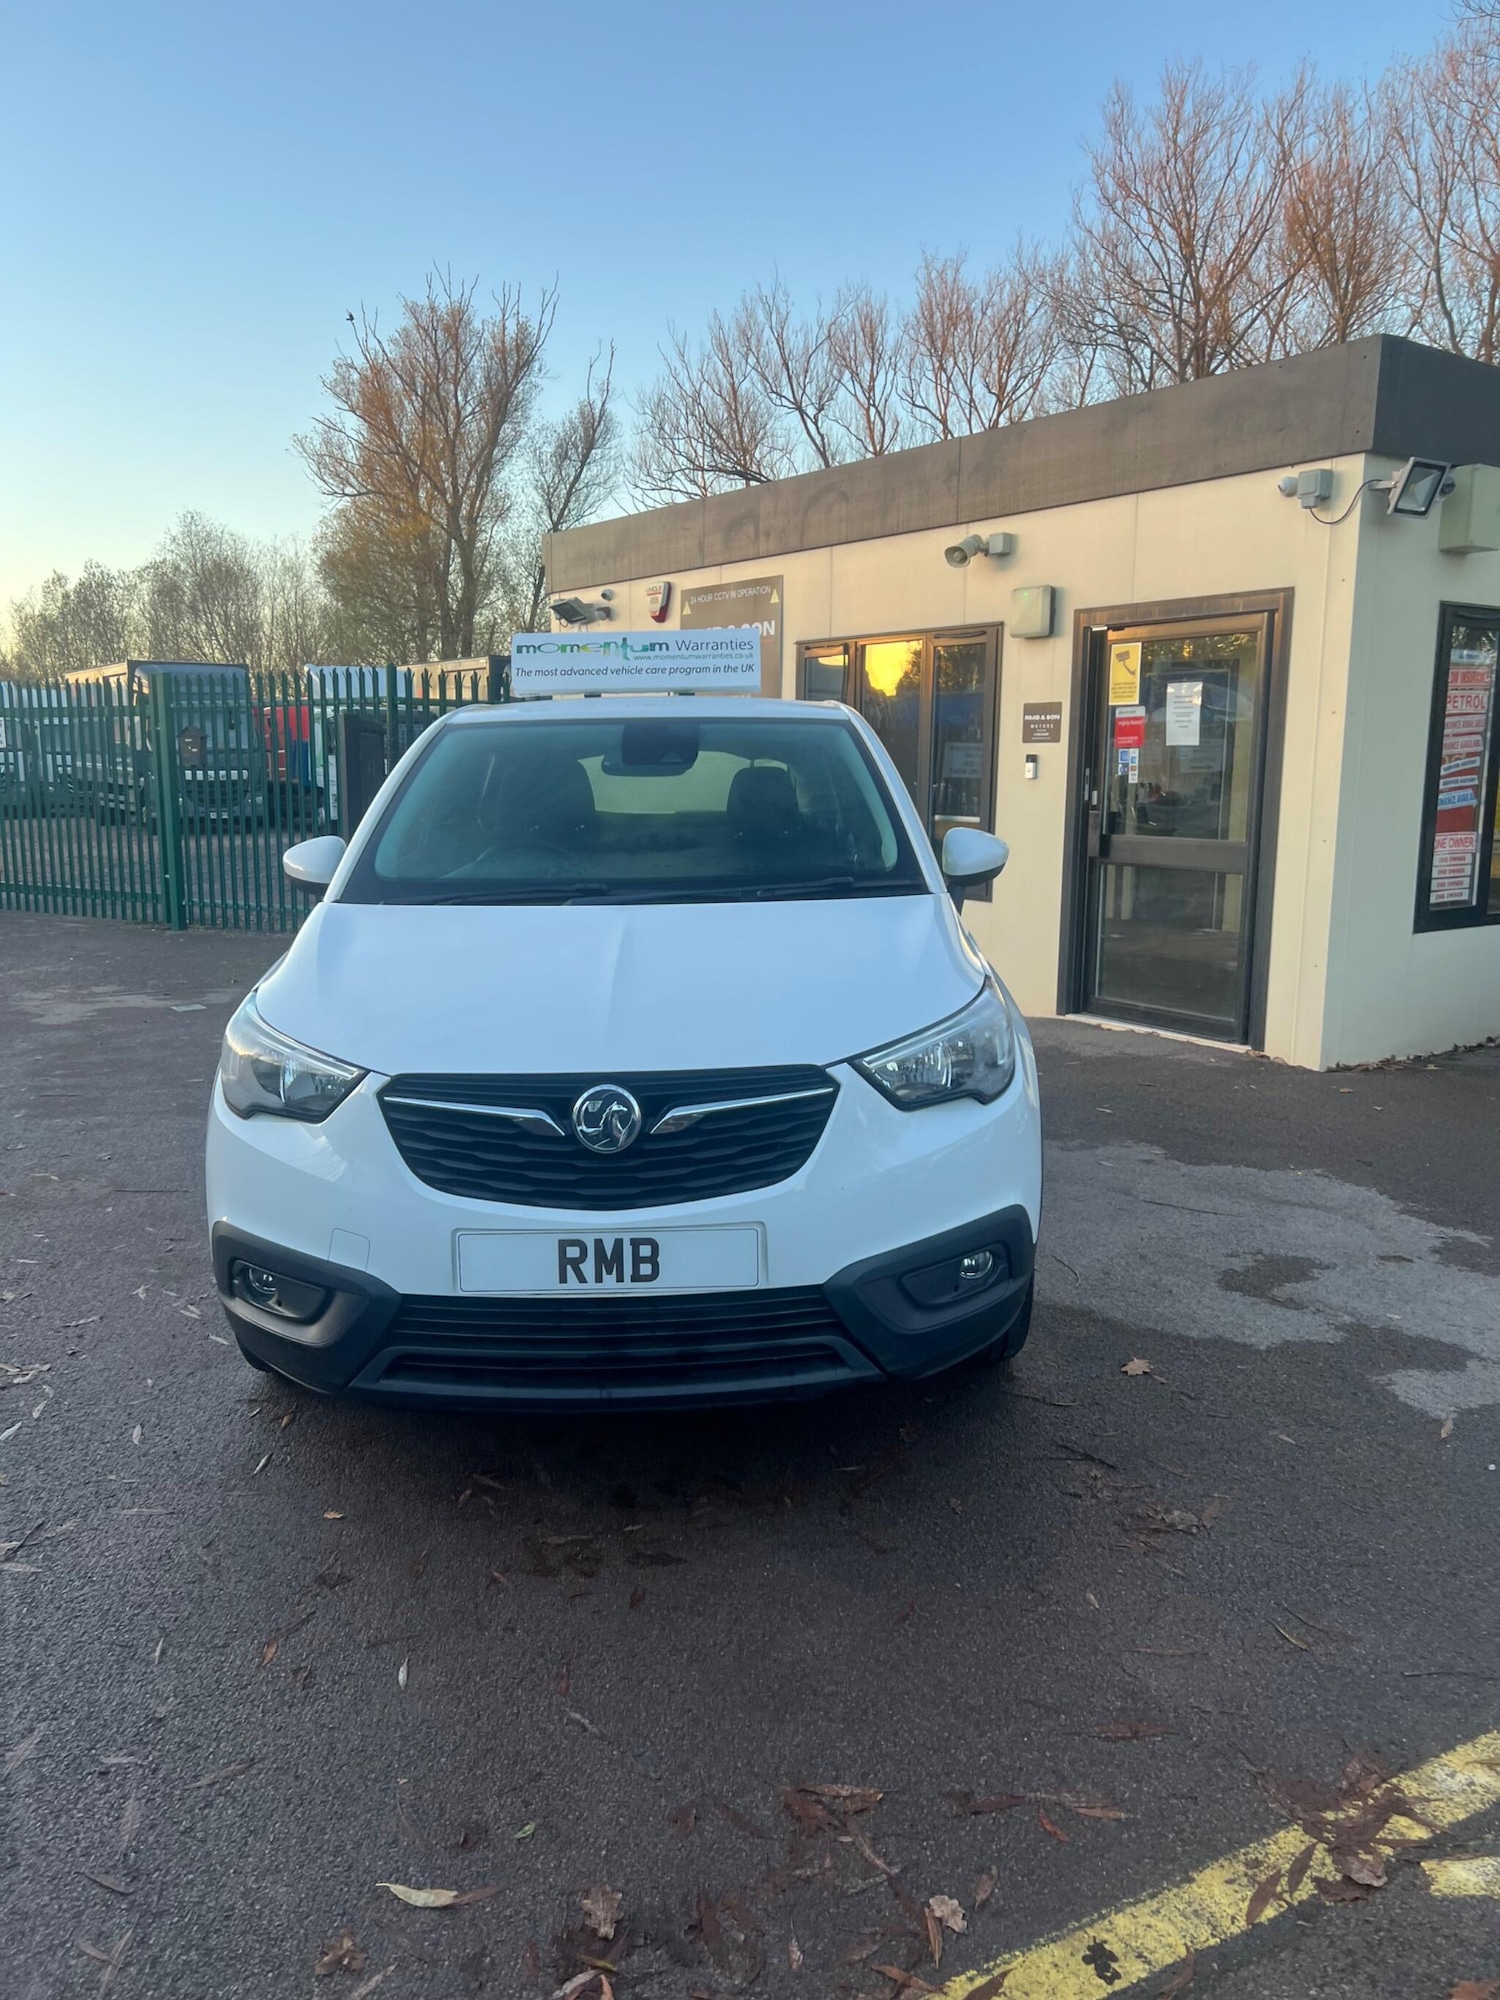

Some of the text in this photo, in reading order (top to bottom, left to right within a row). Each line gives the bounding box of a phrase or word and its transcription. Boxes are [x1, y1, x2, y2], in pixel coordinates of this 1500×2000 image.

[690, 585, 771, 605] 24 HOUR CCTV IN OPERATION
[516, 637, 754, 661] momentum Warranties
[633, 651, 754, 661] www.momentumwarranties.co.uk
[516, 663, 755, 677] The most advanced vehicle care program in the UK
[1448, 836, 1474, 848] OWNER
[557, 1237, 660, 1284] RMB
